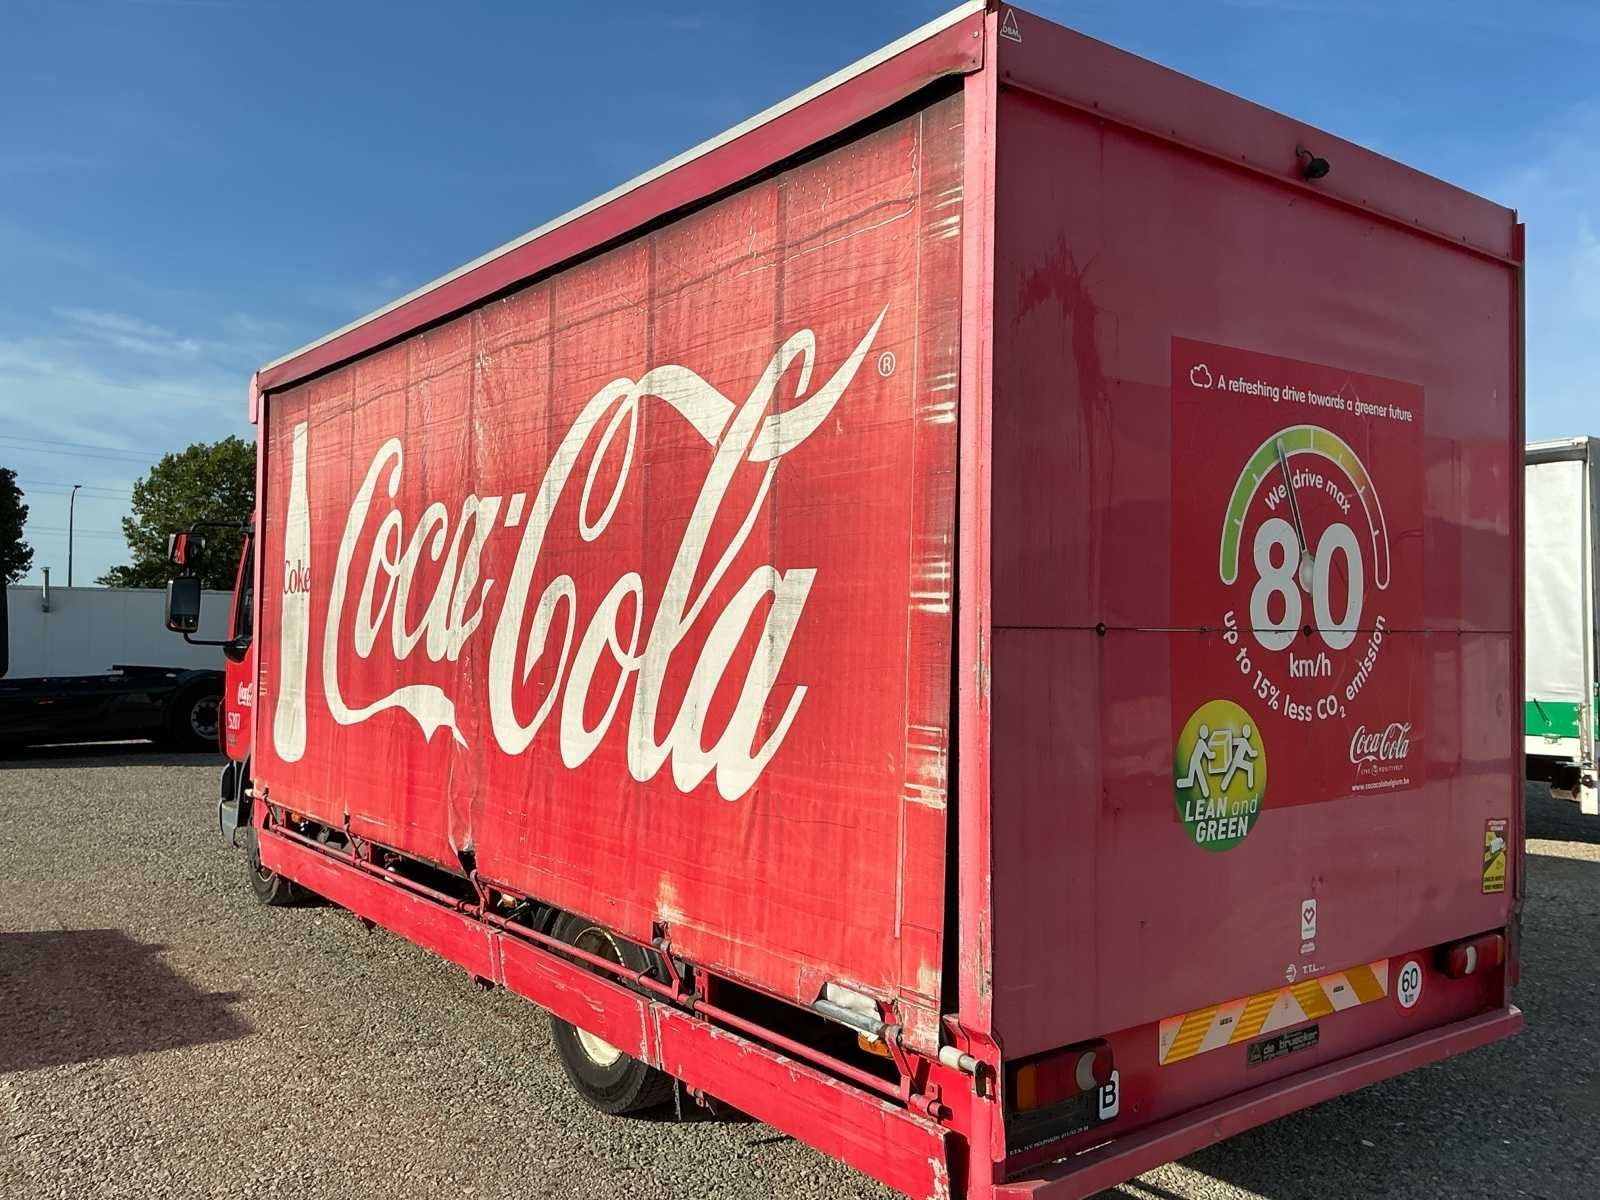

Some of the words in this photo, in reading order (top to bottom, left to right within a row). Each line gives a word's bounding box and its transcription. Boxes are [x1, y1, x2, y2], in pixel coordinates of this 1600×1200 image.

[1217, 374, 1226, 390] A
[1228, 376, 1280, 402] refreshing
[1282, 386, 1306, 402] drive
[1308, 391, 1345, 410] towards
[1346, 400, 1353, 410] a
[1354, 401, 1387, 417] greener
[1389, 403, 1413, 422] future
[1265, 484, 1288, 511] We
[1293, 468, 1323, 489] drive
[1325, 478, 1351, 515] max
[323, 302, 889, 801] Coca-Cola
[283, 559, 312, 594] Coke
[1250, 517, 1364, 651] 80
[1223, 610, 1238, 645] up
[1235, 647, 1251, 674] to
[1252, 670, 1280, 710] 15%
[1283, 694, 1313, 722] less
[1346, 615, 1386, 701] emission
[1289, 652, 1332, 678] km/h
[1350, 722, 1412, 764] Coca-Cola
[1184, 796, 1228, 823] LEAN
[1231, 793, 1258, 815] and
[1195, 815, 1250, 844] GREEN
[1401, 967, 1418, 993] 60
[1102, 1079, 1116, 1110] B
